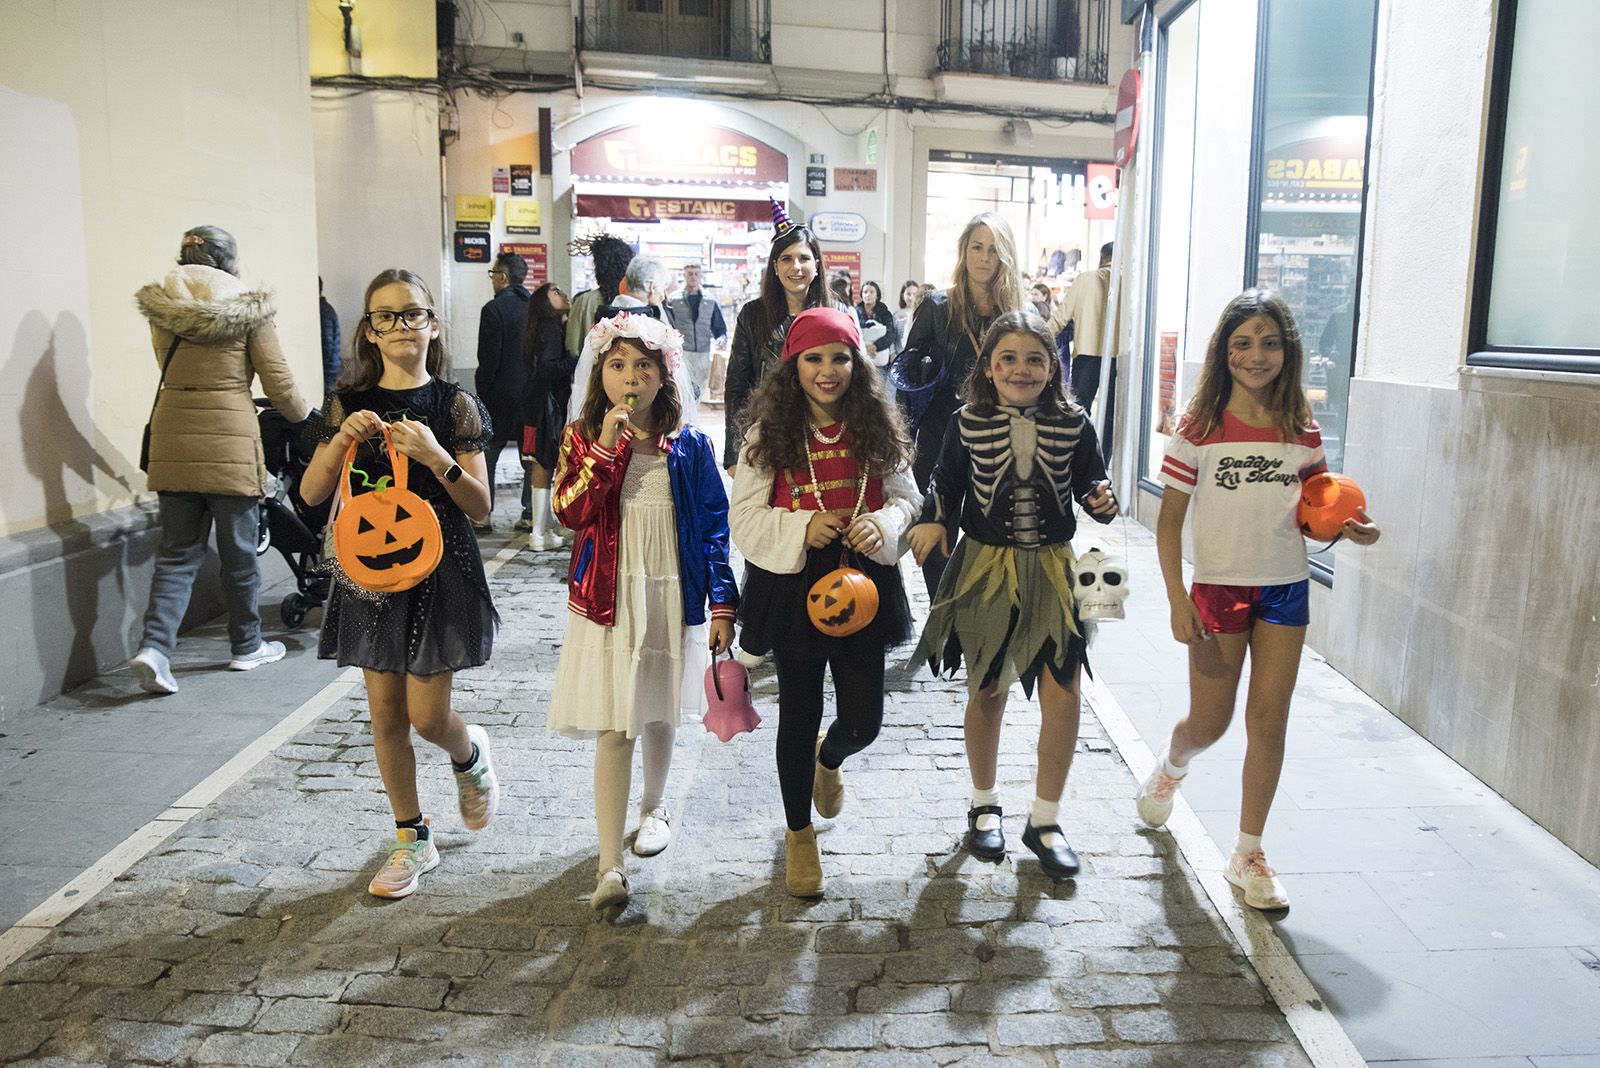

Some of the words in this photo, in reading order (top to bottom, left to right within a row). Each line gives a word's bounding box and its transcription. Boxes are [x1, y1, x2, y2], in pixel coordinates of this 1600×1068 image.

[655, 199, 736, 214] ESTANC
[1217, 455, 1283, 471] Daddy's
[1215, 471, 1241, 490] Lil
